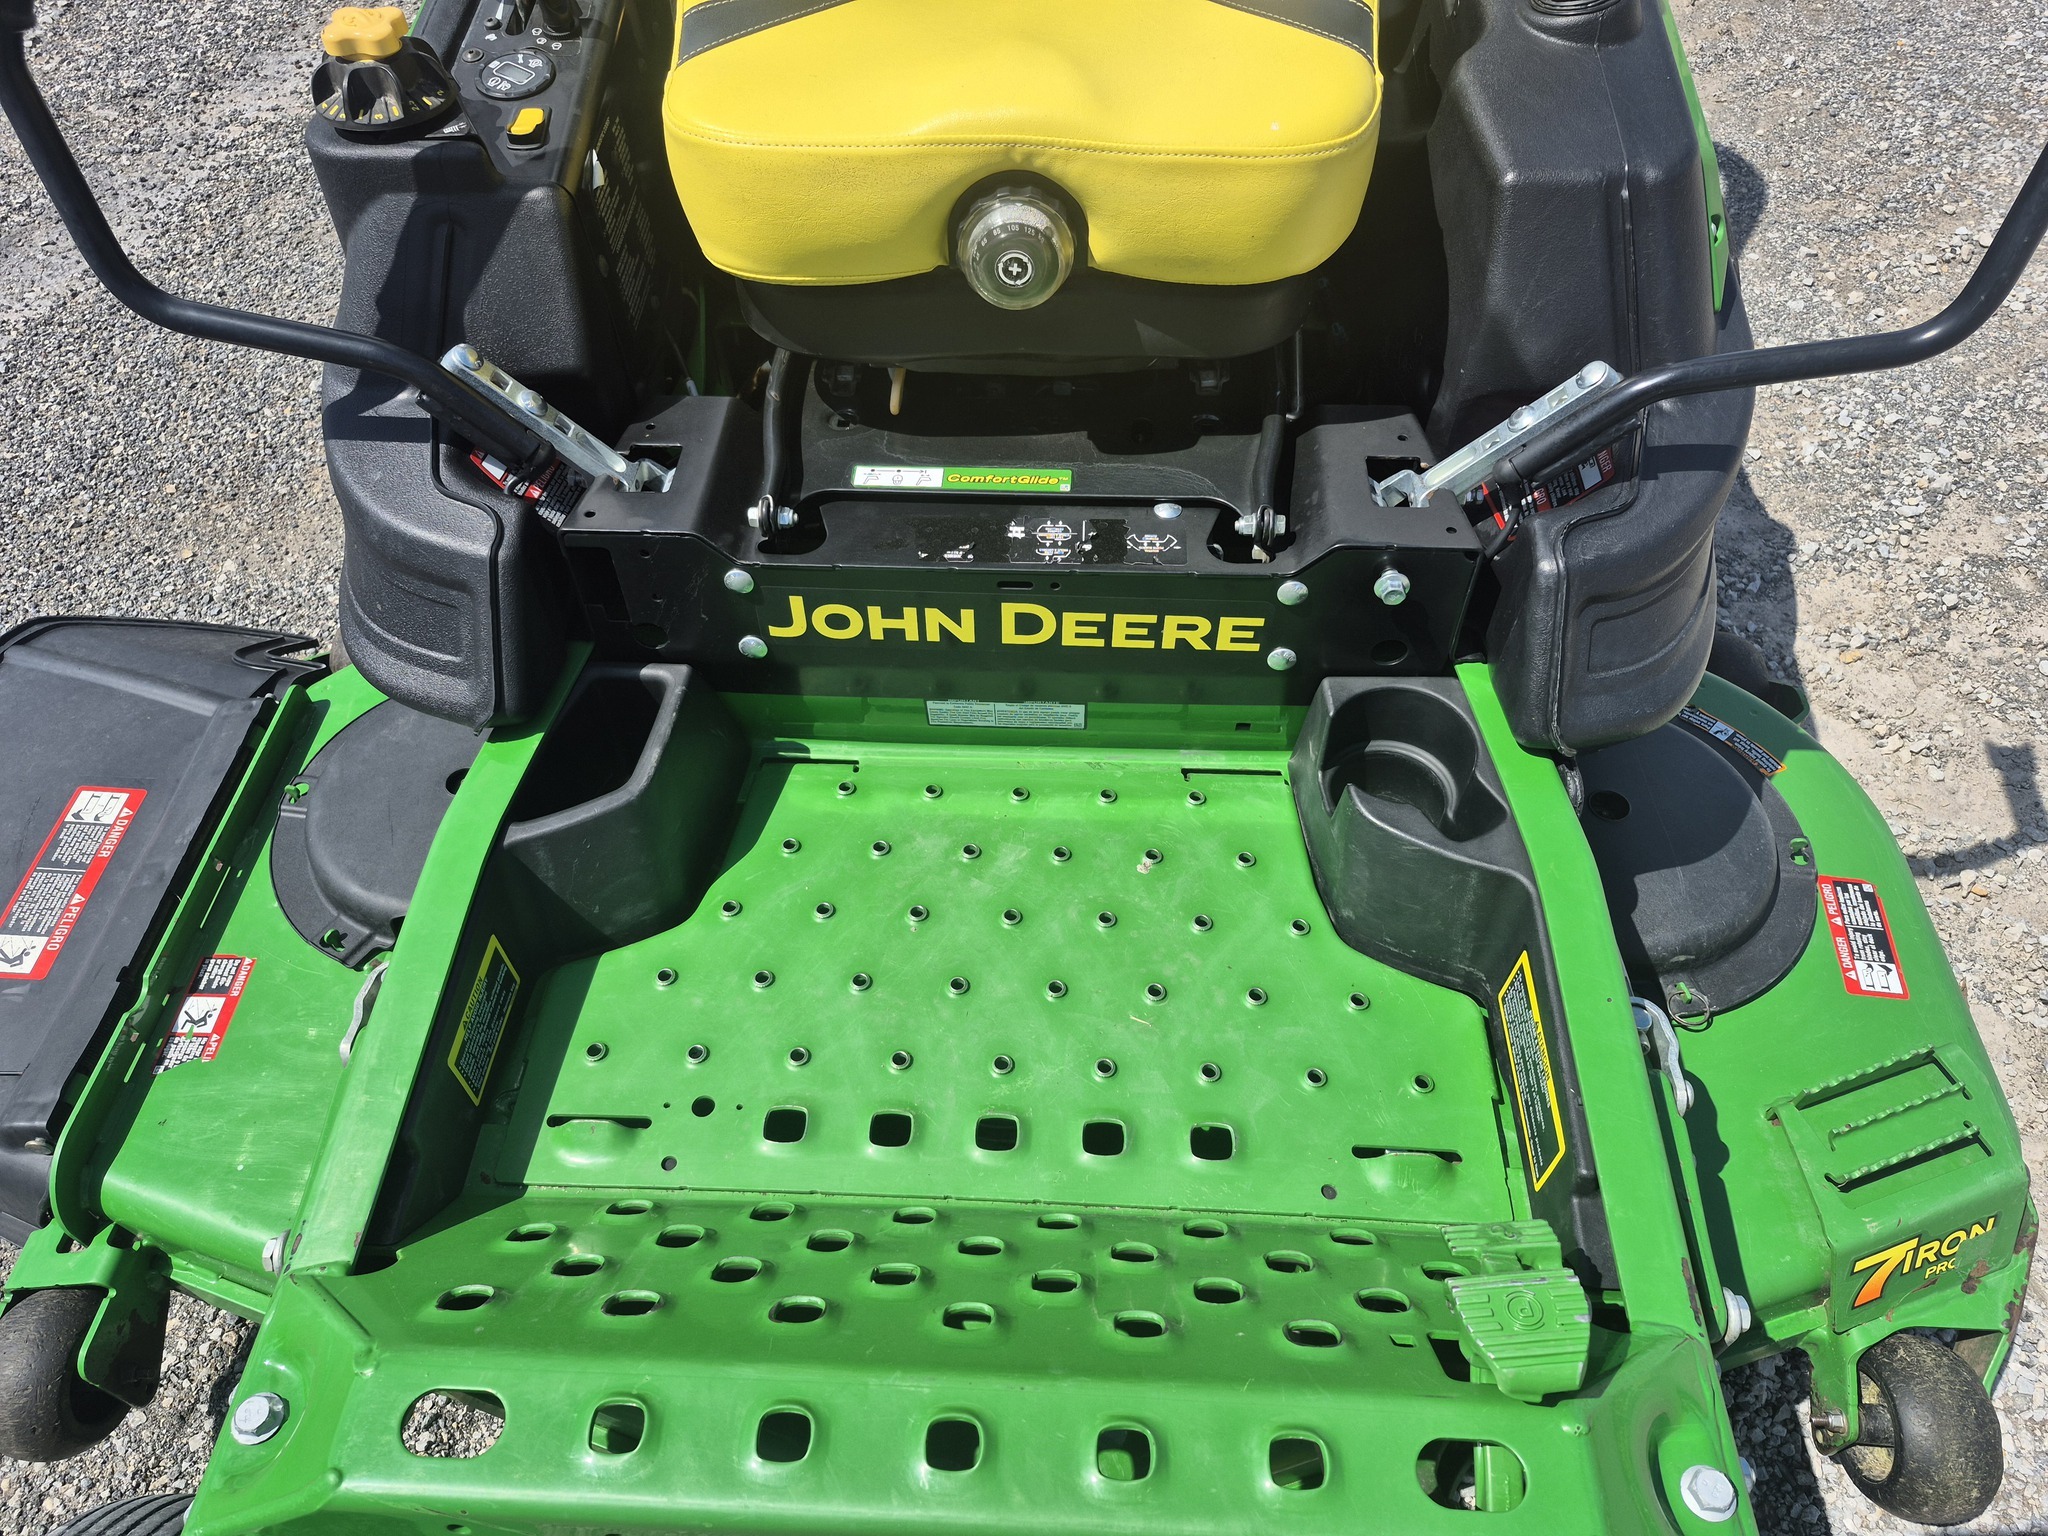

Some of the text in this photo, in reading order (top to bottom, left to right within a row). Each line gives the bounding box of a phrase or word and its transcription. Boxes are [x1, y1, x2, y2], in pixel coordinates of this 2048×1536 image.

[1007, 224, 1020, 232] 105
[1024, 226, 1036, 237] 125
[768, 595, 1266, 652] JOHN DEERE
[96, 819, 128, 857] DANGER
[1821, 883, 1839, 915] PELIGRO
[46, 905, 76, 951] PELIGRO
[1836, 937, 1853, 968] DANGER
[229, 965, 250, 997] DANGER
[466, 976, 483, 1019] CAUTION
